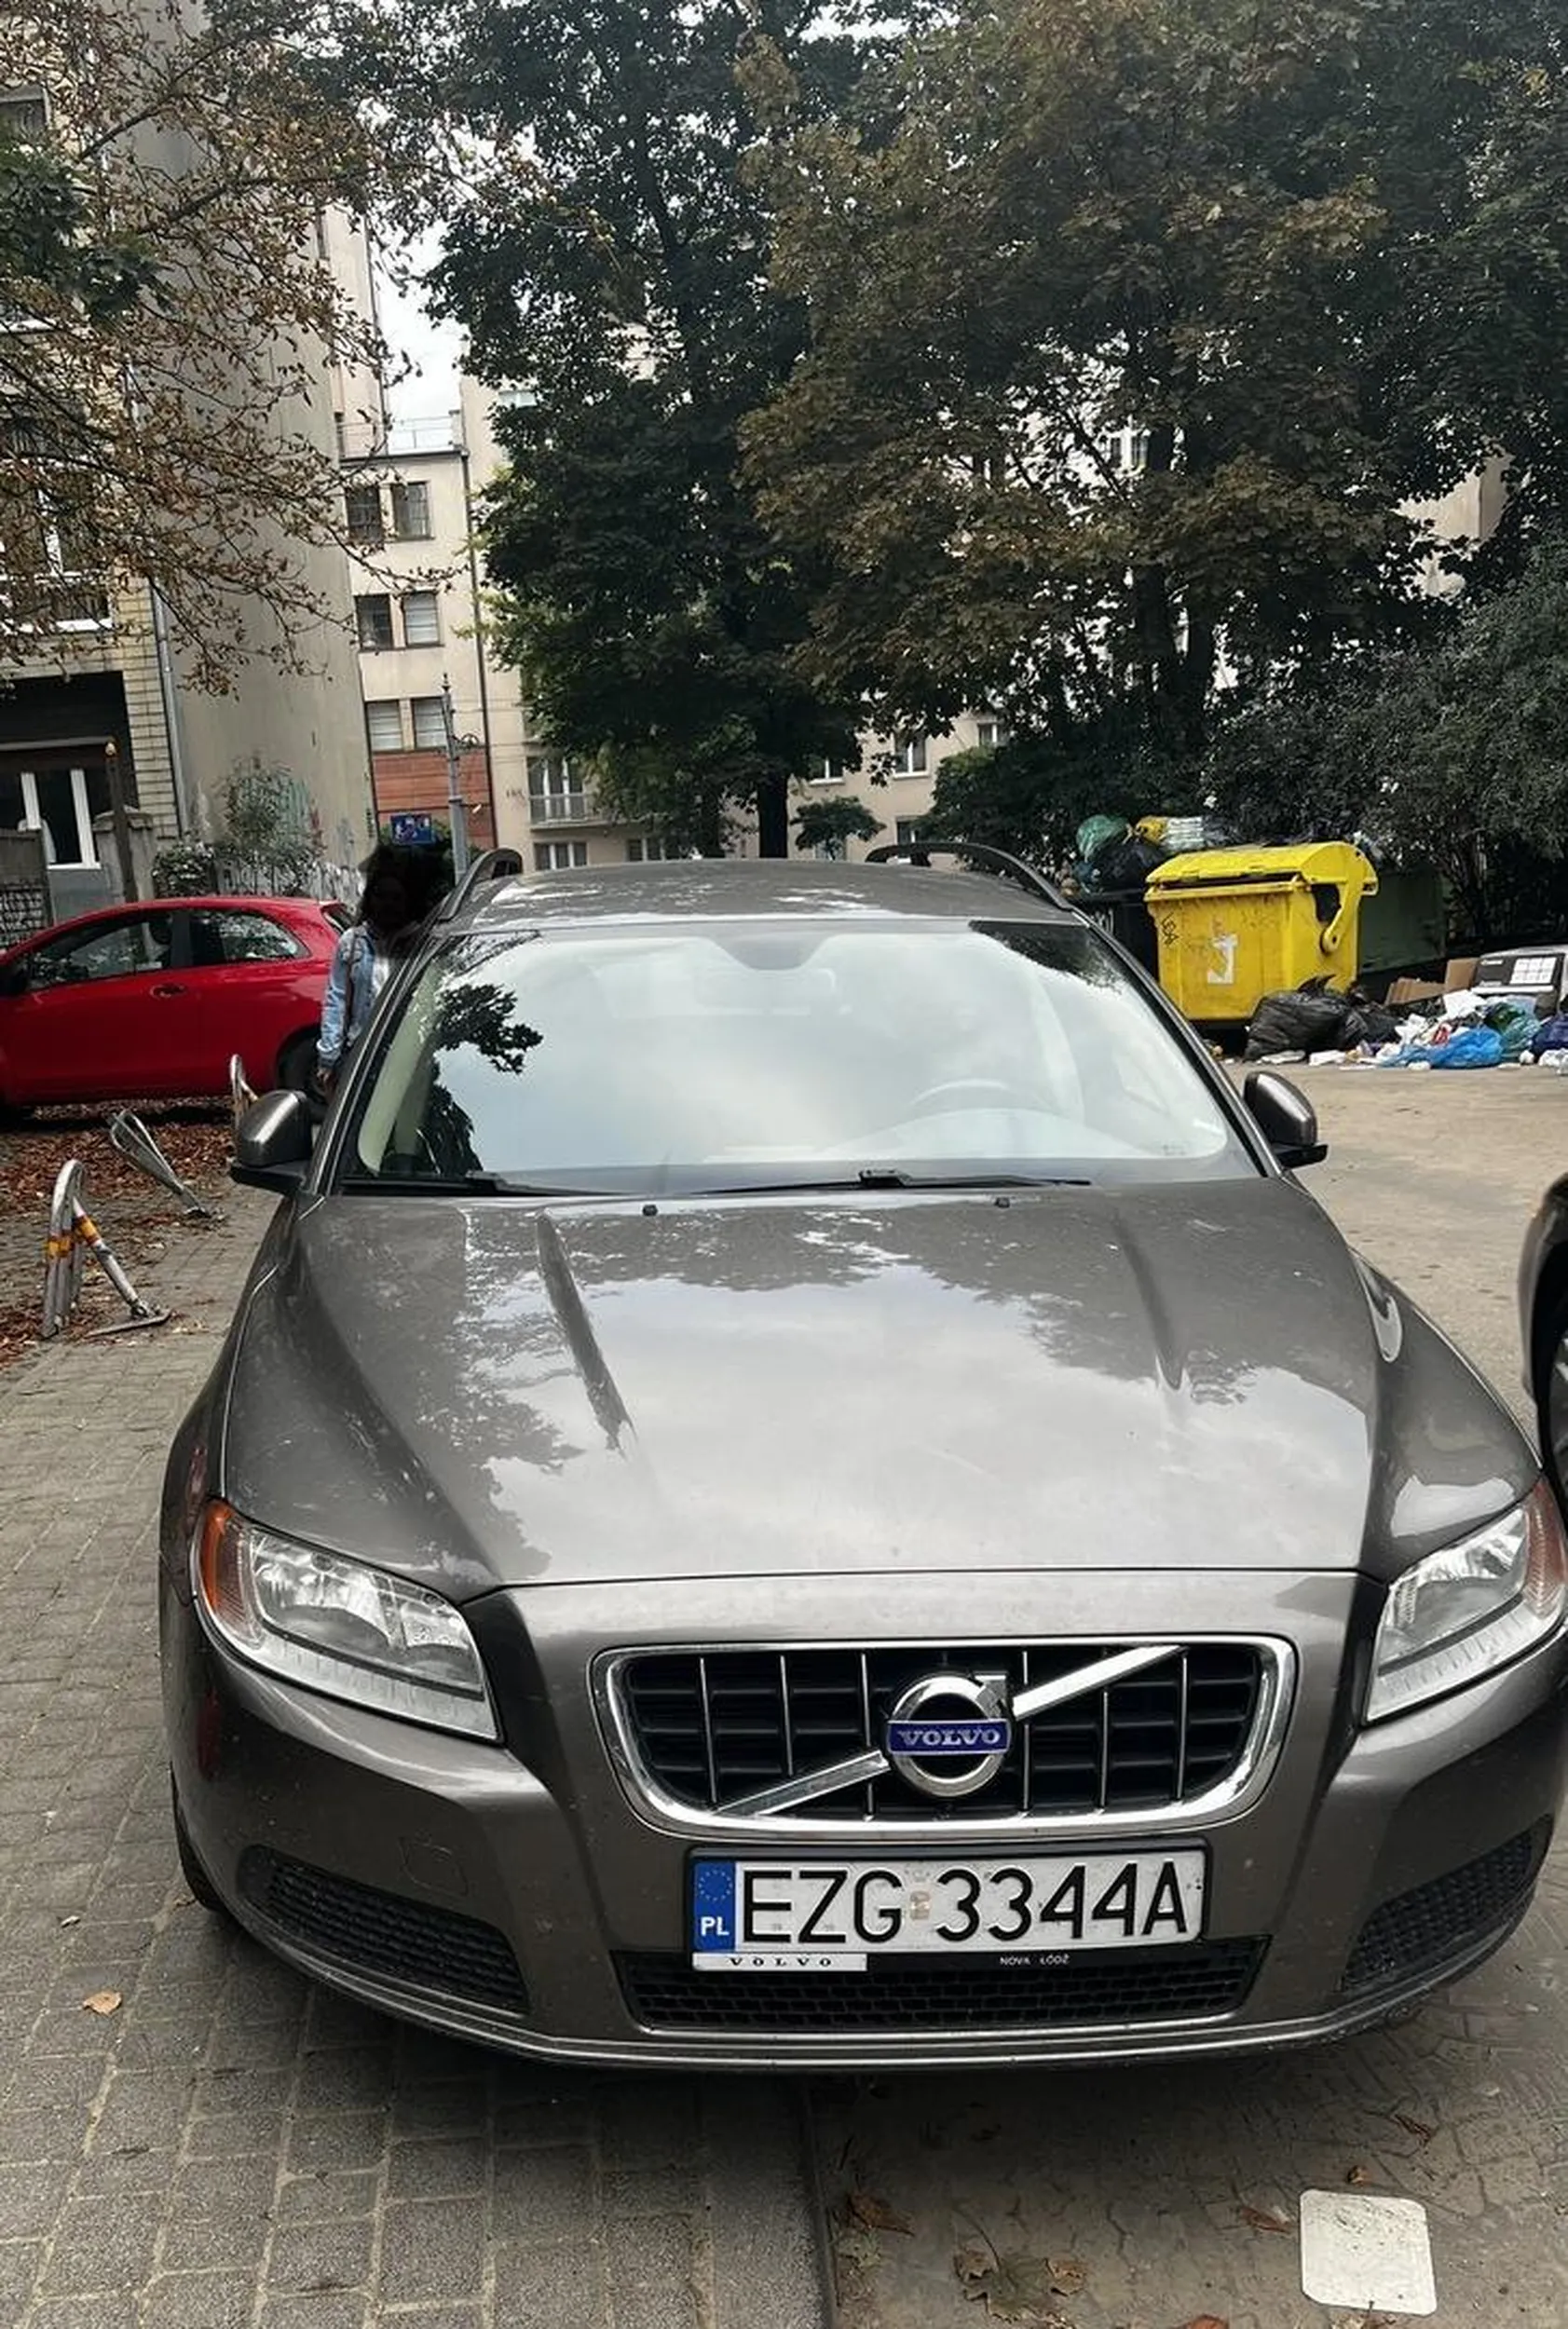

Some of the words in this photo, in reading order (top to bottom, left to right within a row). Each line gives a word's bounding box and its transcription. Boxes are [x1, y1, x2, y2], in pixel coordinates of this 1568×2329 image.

[897, 1729, 1000, 1746] VOLVO
[744, 1870, 902, 1943] EZG
[936, 1861, 1186, 1941] 3344A
[701, 1916, 729, 1937] PL
[730, 1957, 831, 1967] VOLVO
